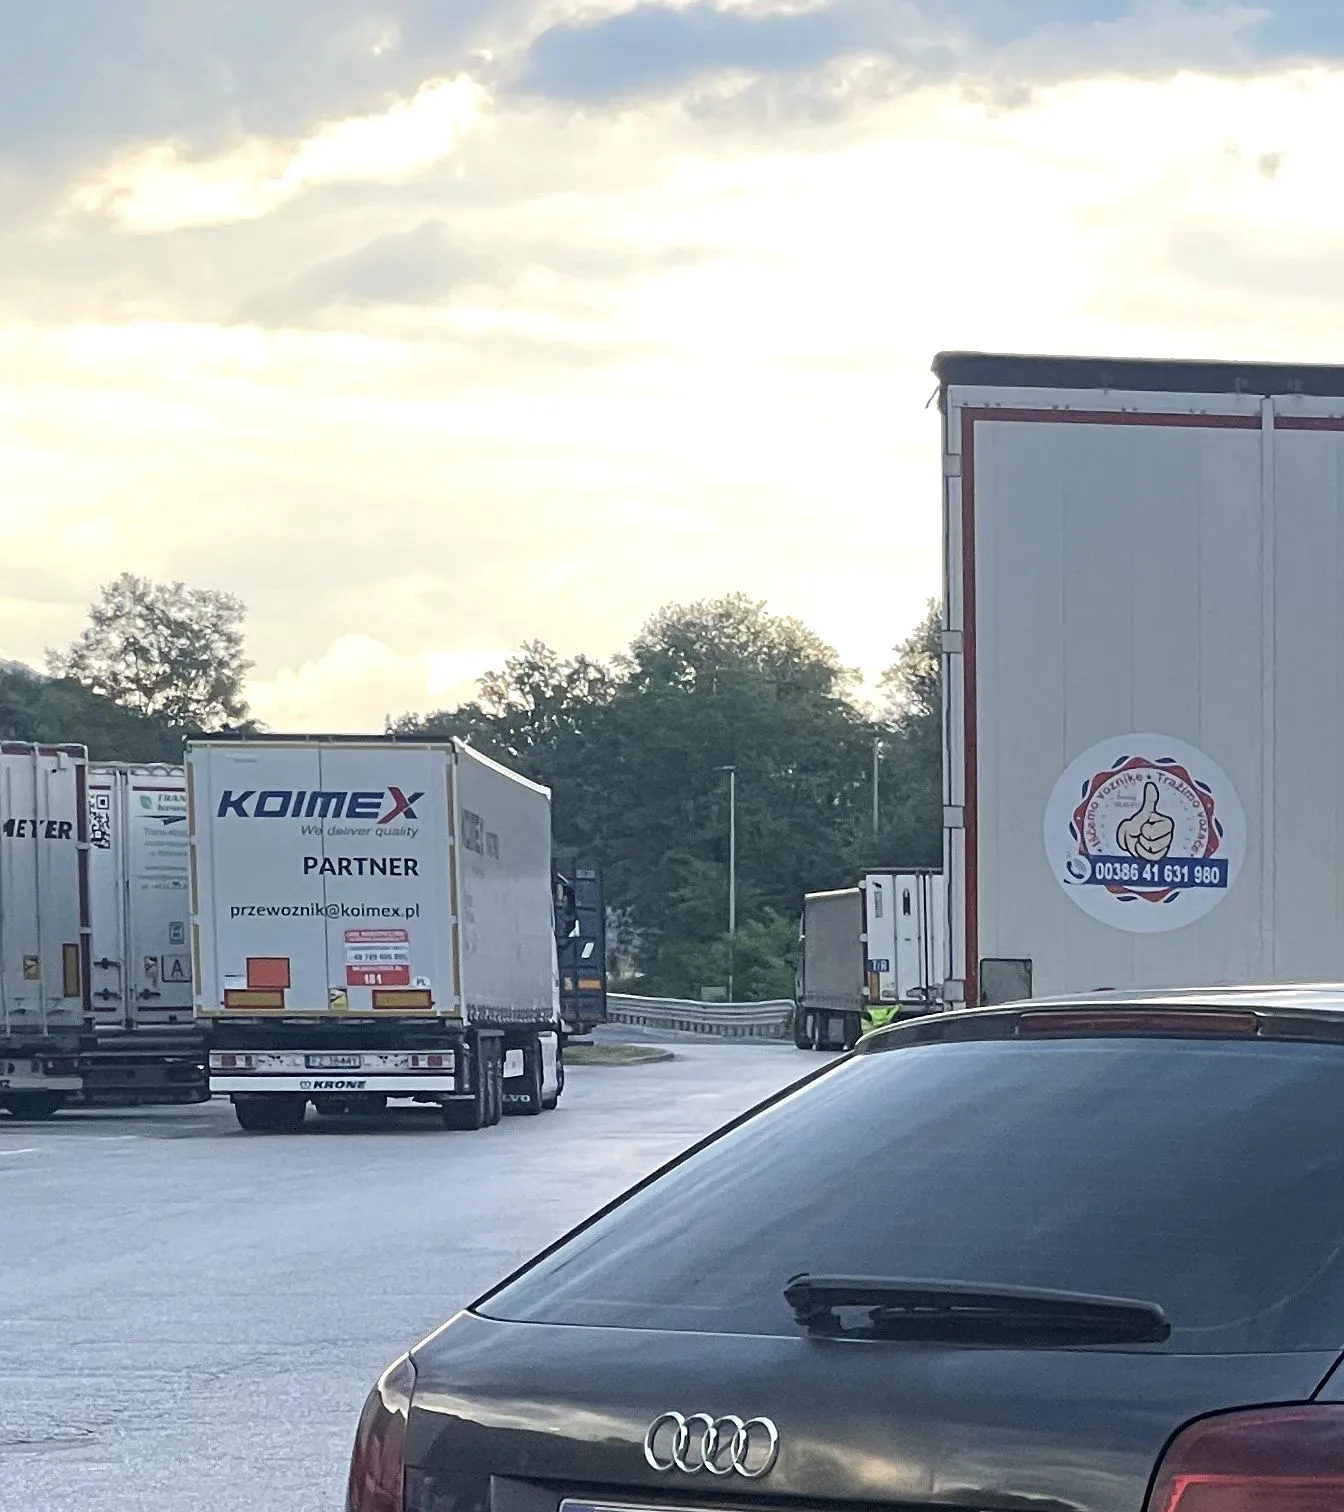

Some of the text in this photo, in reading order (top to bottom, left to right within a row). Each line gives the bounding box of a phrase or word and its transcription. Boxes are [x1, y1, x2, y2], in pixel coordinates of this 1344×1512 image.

[1097, 773, 1143, 799] voznike
[1157, 772, 1200, 808] Tražimo
[216, 786, 425, 825] KOIMEX
[301, 825, 419, 838] We deliver quality
[303, 856, 419, 876] PARTNER
[1095, 862, 1220, 884] 00386 41 631 980
[230, 903, 420, 920] przewoznik@koimex.pl
[170, 959, 185, 977] A
[313, 1080, 367, 1089] KRONE
